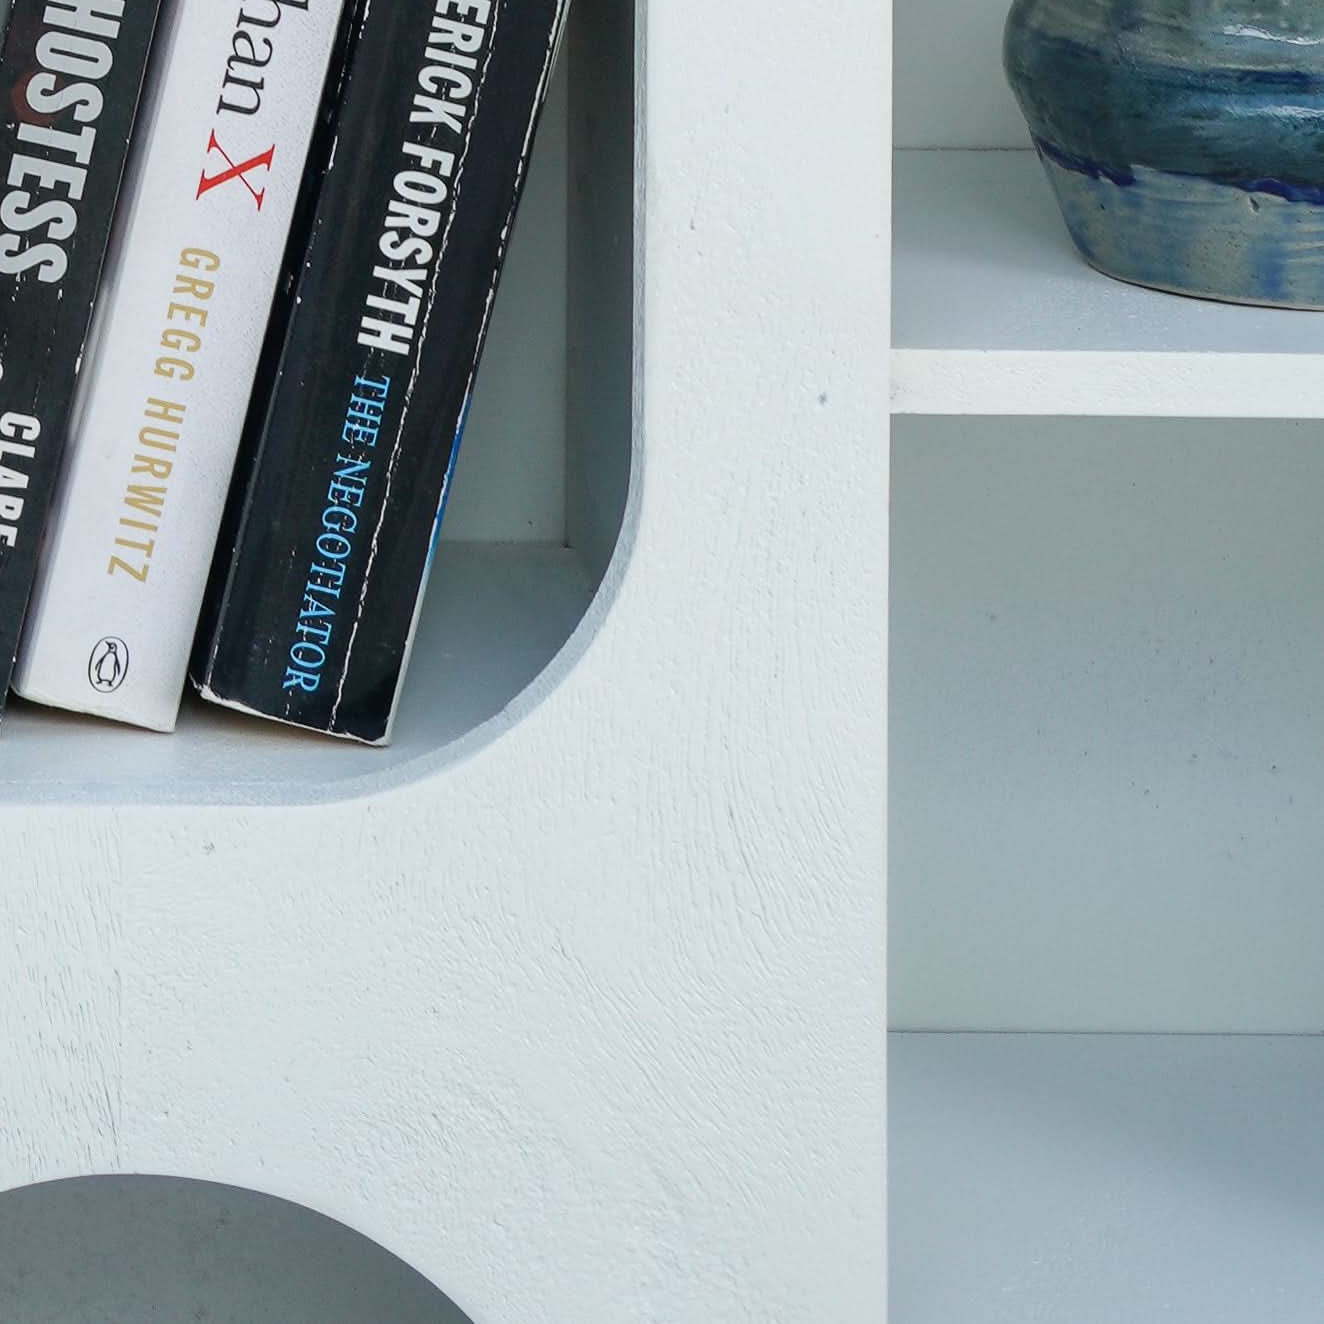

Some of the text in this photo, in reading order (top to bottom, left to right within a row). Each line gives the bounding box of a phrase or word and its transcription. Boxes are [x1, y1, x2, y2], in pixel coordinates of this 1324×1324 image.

[195, 128, 276, 212] X
[357, 142, 454, 357] FORSYTH
[107, 247, 221, 584] GREGG HURWITZ
[283, 375, 390, 692] THE NEGOTIATOR
